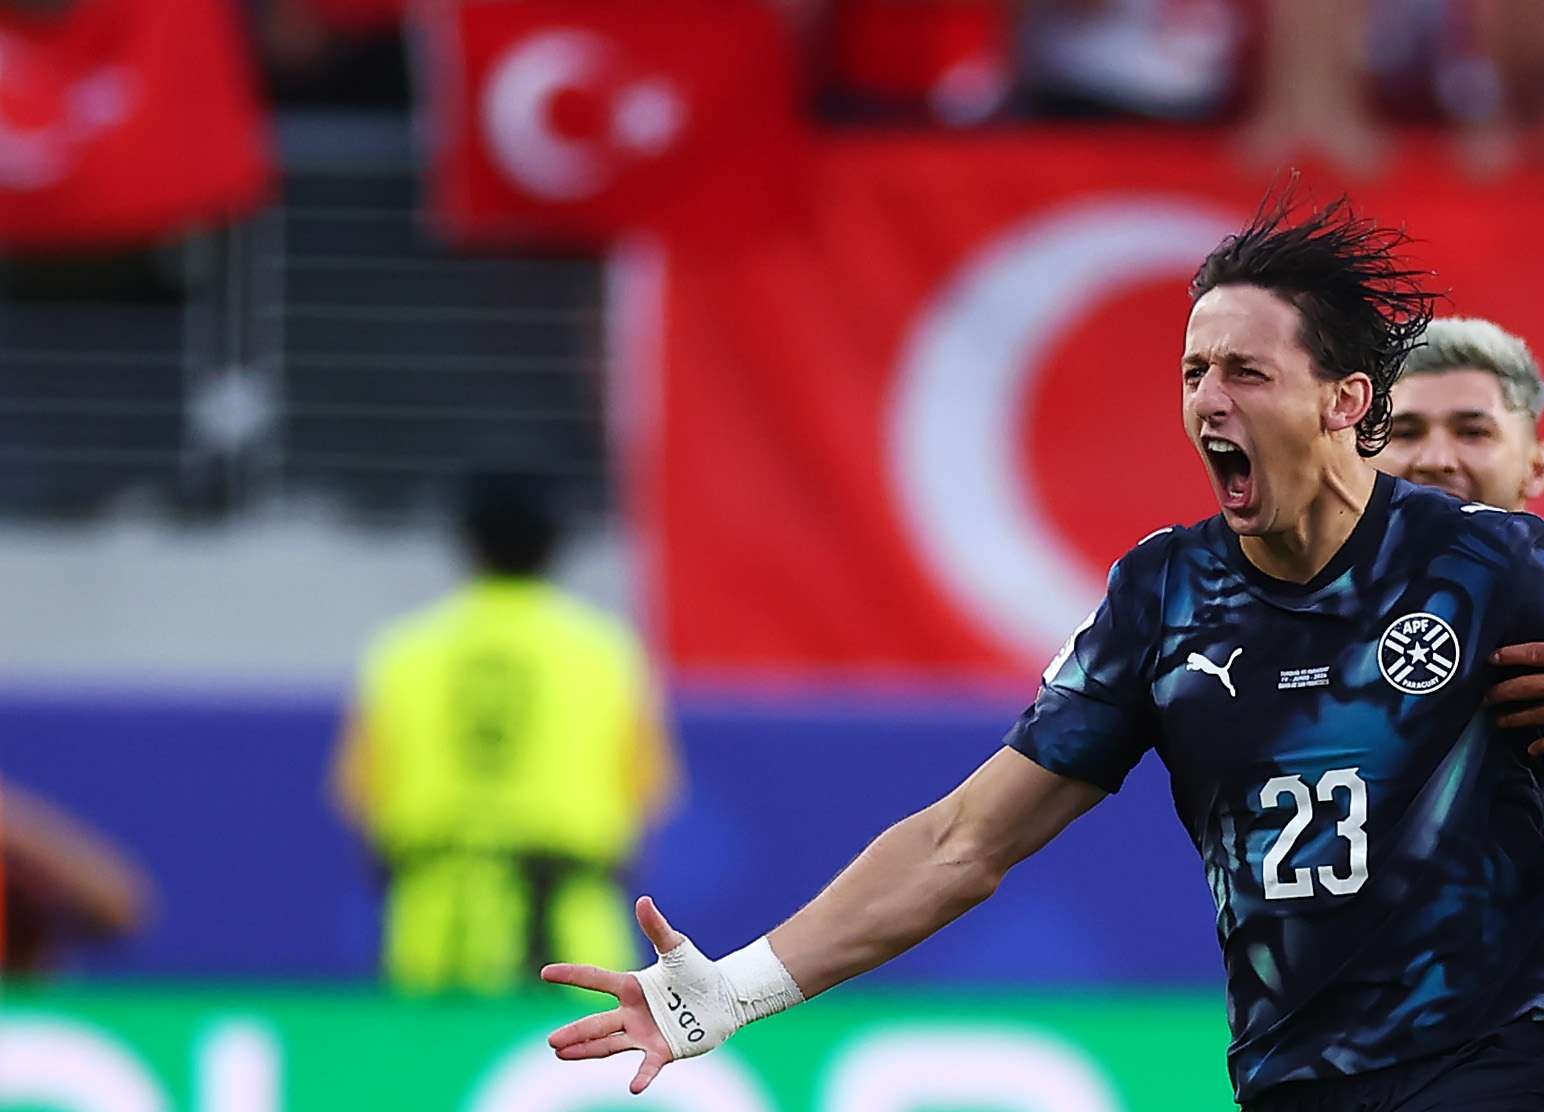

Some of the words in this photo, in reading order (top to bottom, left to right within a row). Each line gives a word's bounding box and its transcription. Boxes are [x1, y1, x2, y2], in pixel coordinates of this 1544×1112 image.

[1402, 619, 1429, 634] APF
[1402, 676, 1439, 689] PARAGUAY
[1260, 767, 1369, 899] 23
